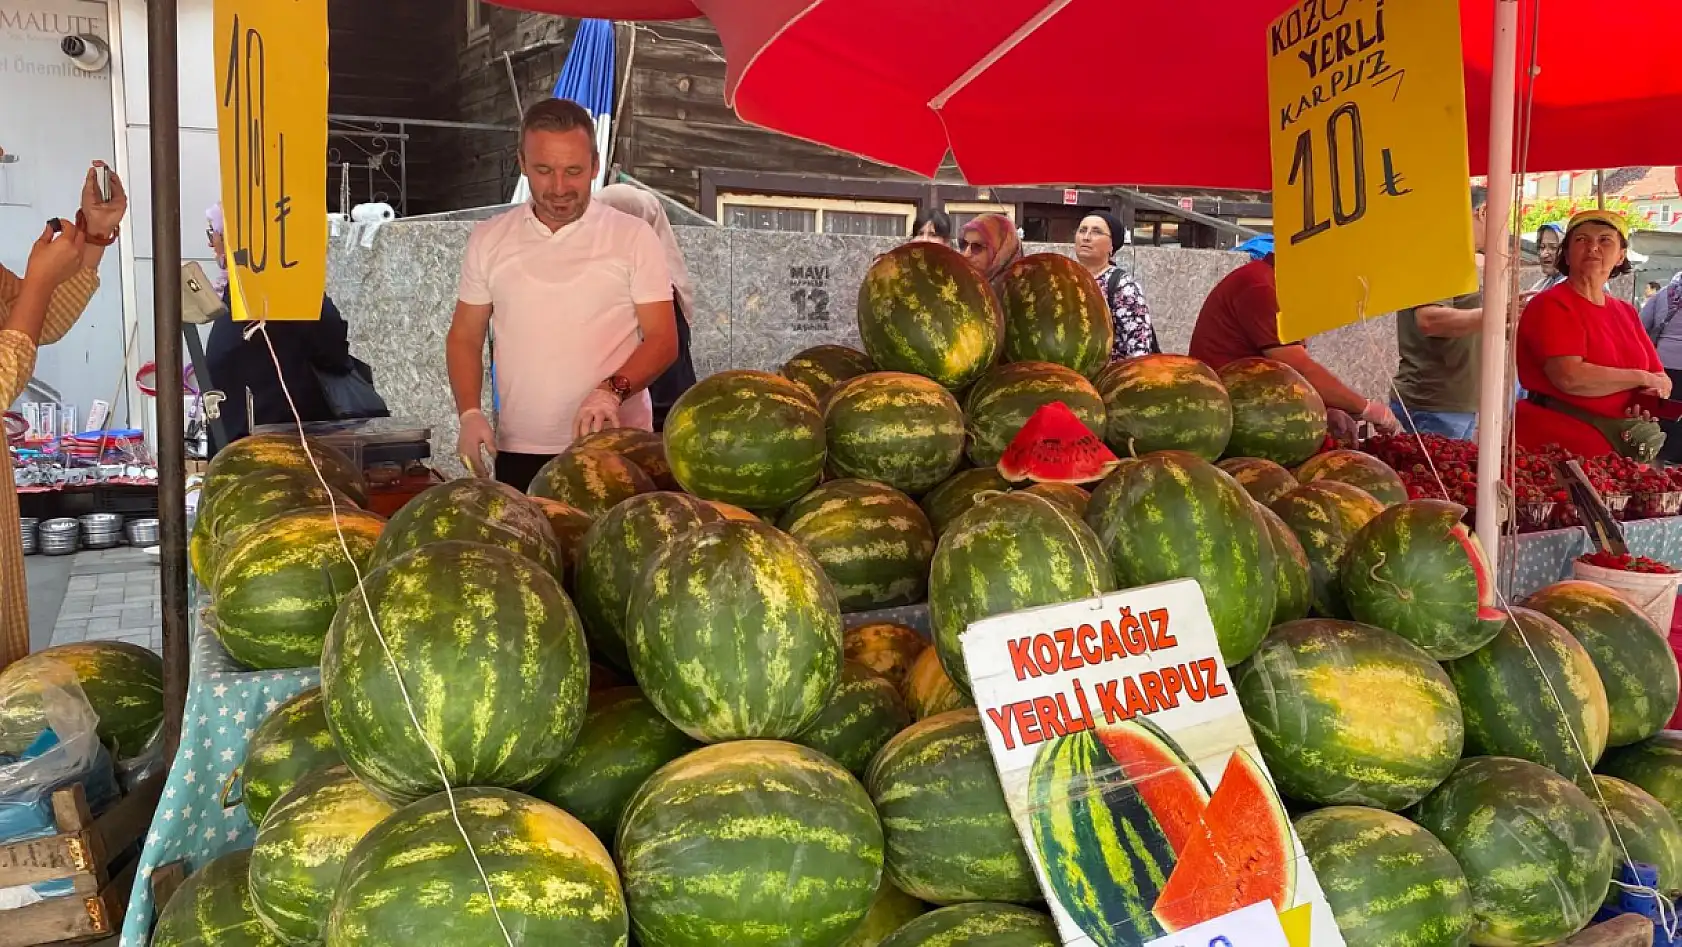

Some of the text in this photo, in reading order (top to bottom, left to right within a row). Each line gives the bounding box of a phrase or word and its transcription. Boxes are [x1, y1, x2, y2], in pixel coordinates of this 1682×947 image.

[1298, 0, 1385, 78] YERLİ
[1281, 50, 1391, 131] KARPUZ
[224, 13, 267, 273] 10
[1287, 101, 1367, 245] 10
[789, 288, 831, 321] 12
[1007, 606, 1178, 682] KOZCAĞIZ
[986, 657, 1228, 750] YERLİ KARPUZ
